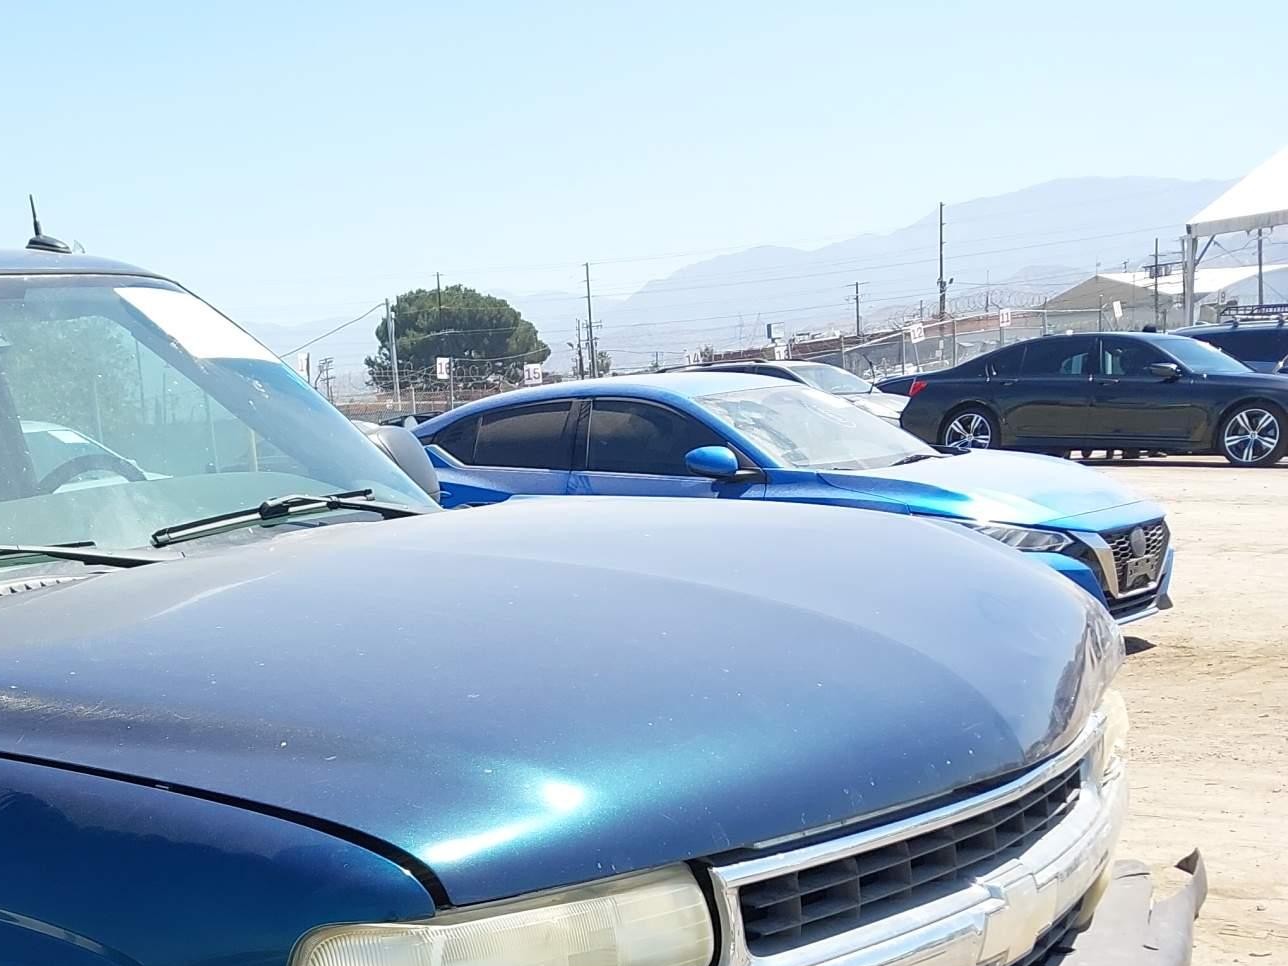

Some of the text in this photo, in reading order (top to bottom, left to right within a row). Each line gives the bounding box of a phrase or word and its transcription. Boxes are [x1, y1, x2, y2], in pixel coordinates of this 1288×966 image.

[1000, 312, 1009, 323] 11
[912, 326, 923, 339] 12
[685, 352, 700, 364] 14
[525, 368, 540, 380] 15
